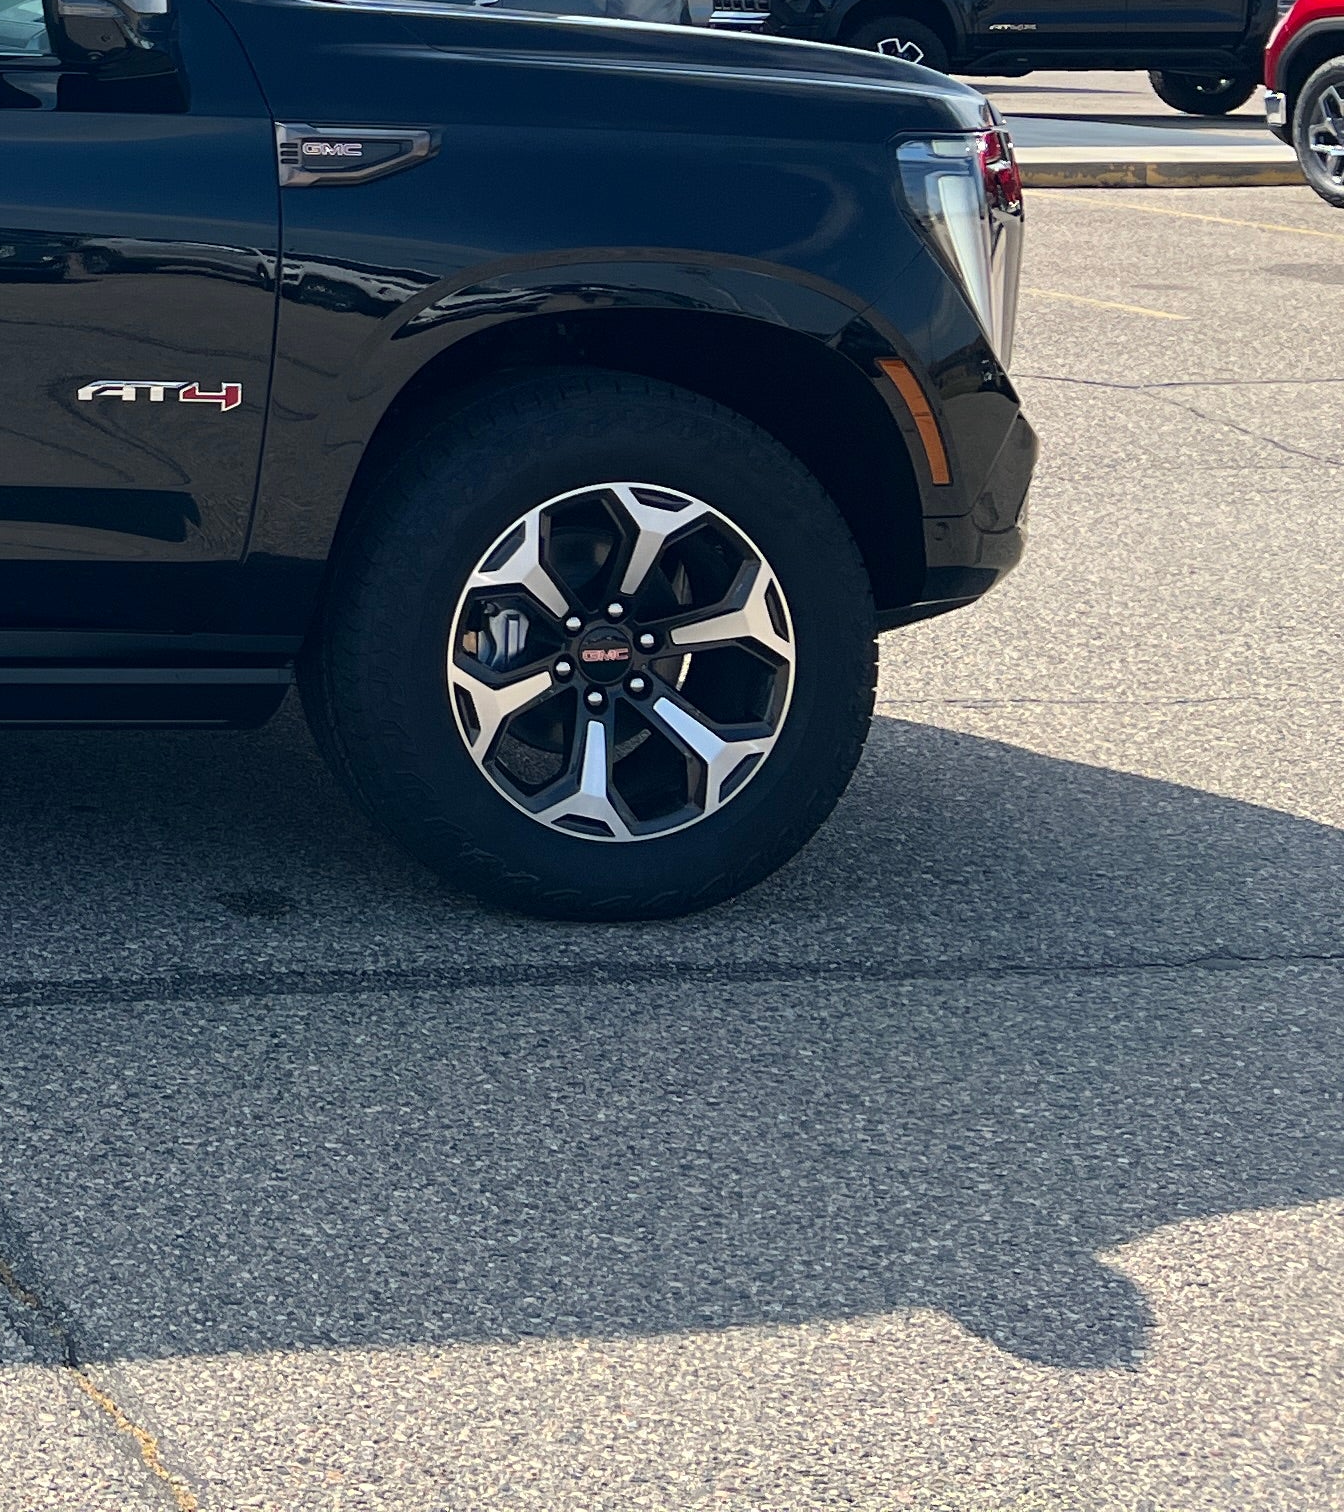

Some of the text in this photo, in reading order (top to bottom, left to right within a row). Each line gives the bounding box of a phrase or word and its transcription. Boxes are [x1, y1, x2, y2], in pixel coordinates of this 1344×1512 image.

[302, 142, 362, 156] GMC
[77, 379, 243, 412] AT4
[581, 647, 630, 663] GMC
